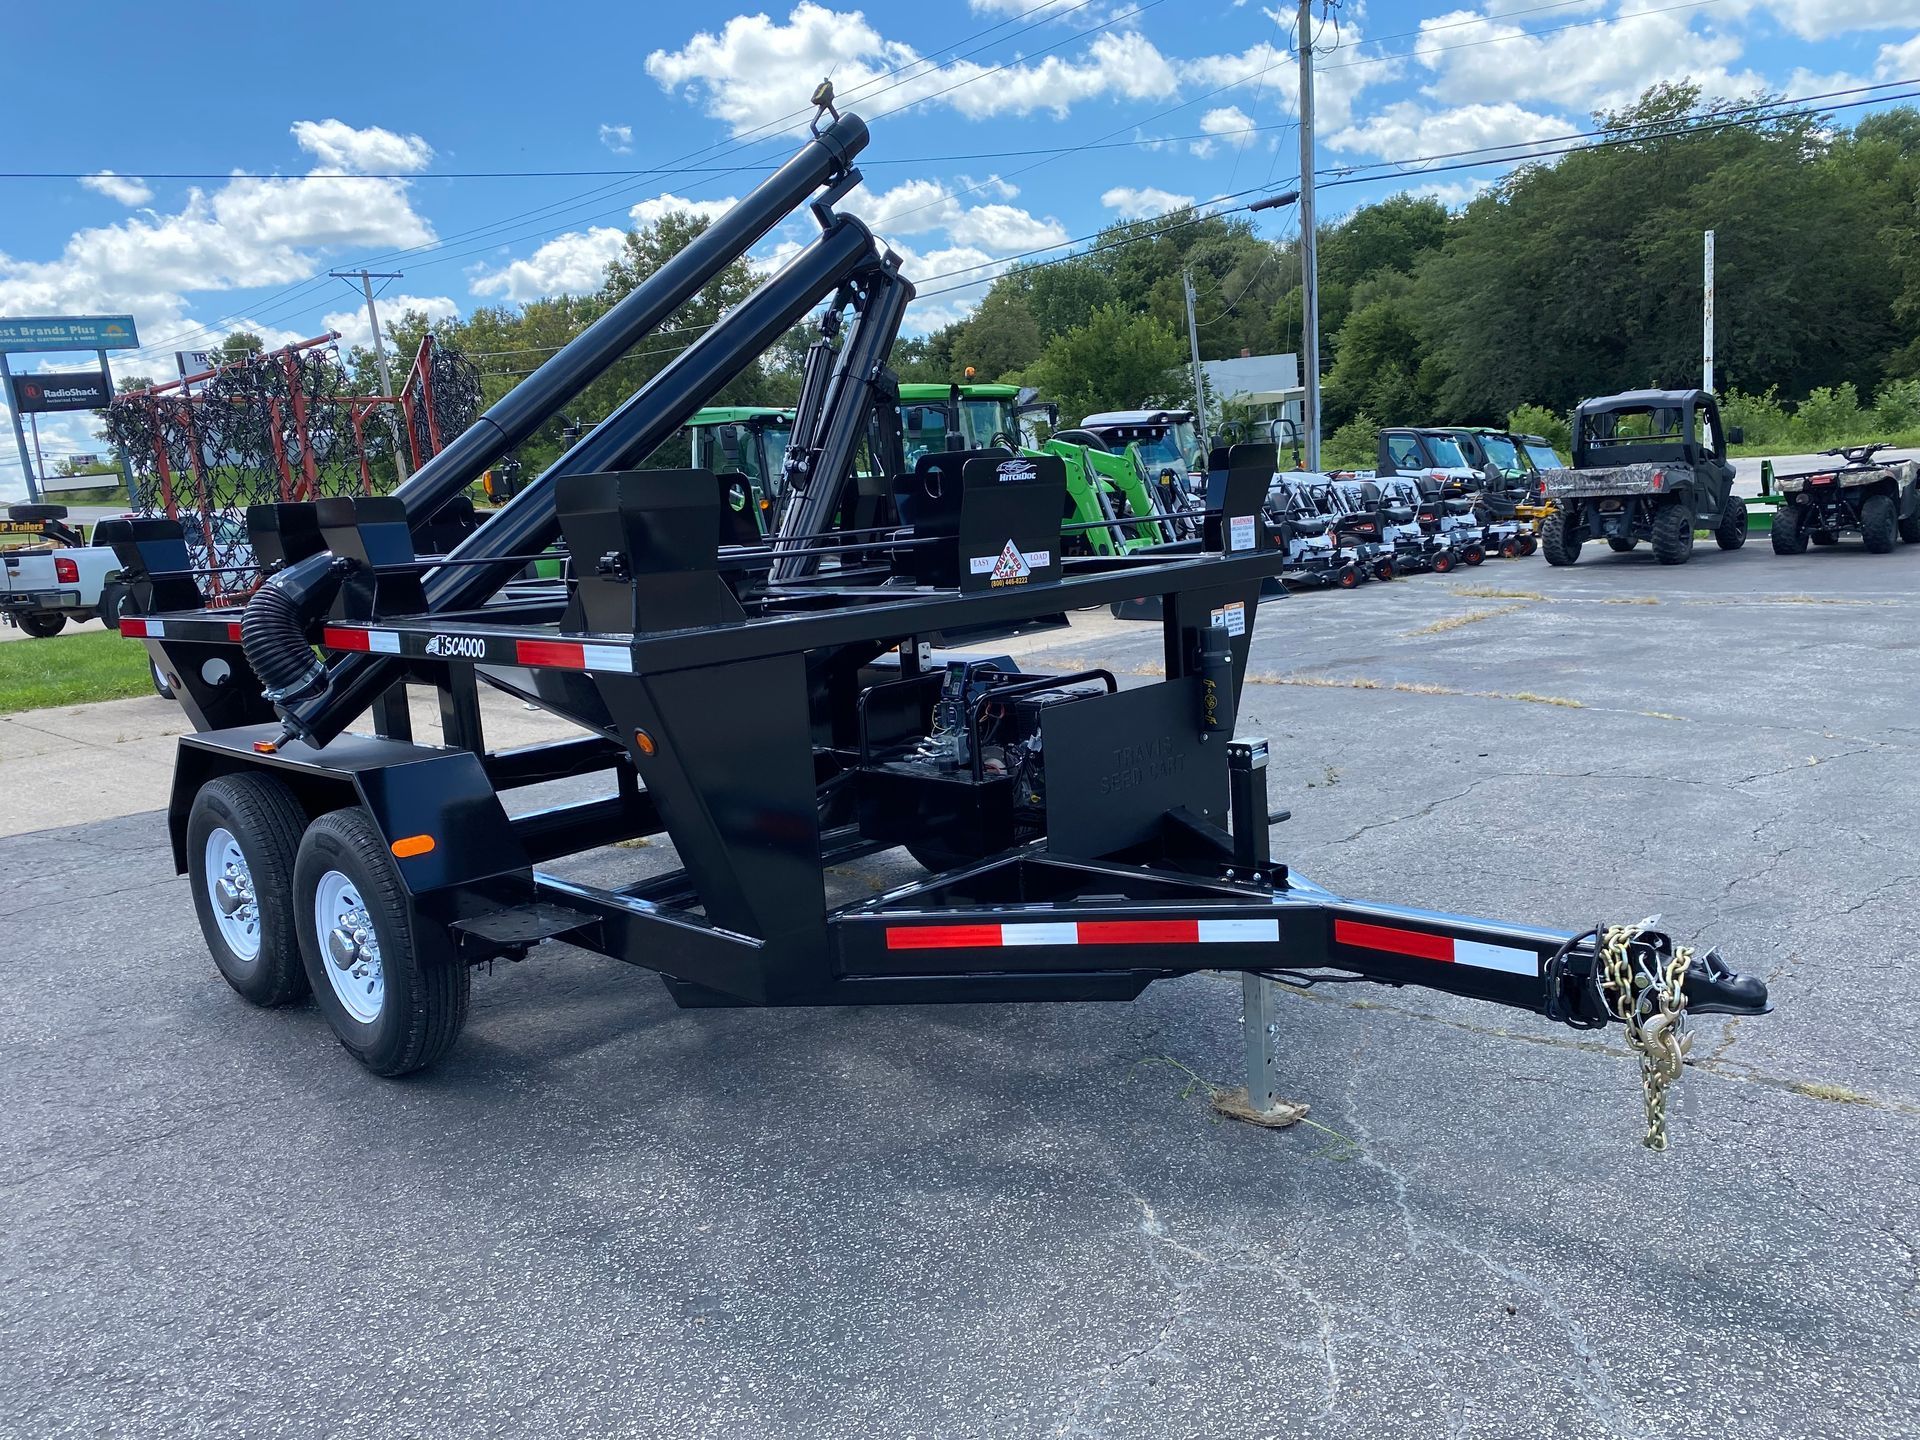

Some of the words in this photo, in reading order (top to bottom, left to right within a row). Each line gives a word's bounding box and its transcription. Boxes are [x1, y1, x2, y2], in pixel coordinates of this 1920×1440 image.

[20, 326, 65, 336] Brands
[69, 325, 95, 334] Plus
[10, 522, 44, 531] Trailers
[1030, 553, 1048, 561] LOAD
[1000, 570, 1018, 578] CART
[1101, 767, 1143, 794] SEED
[1150, 752, 1186, 780] CART
